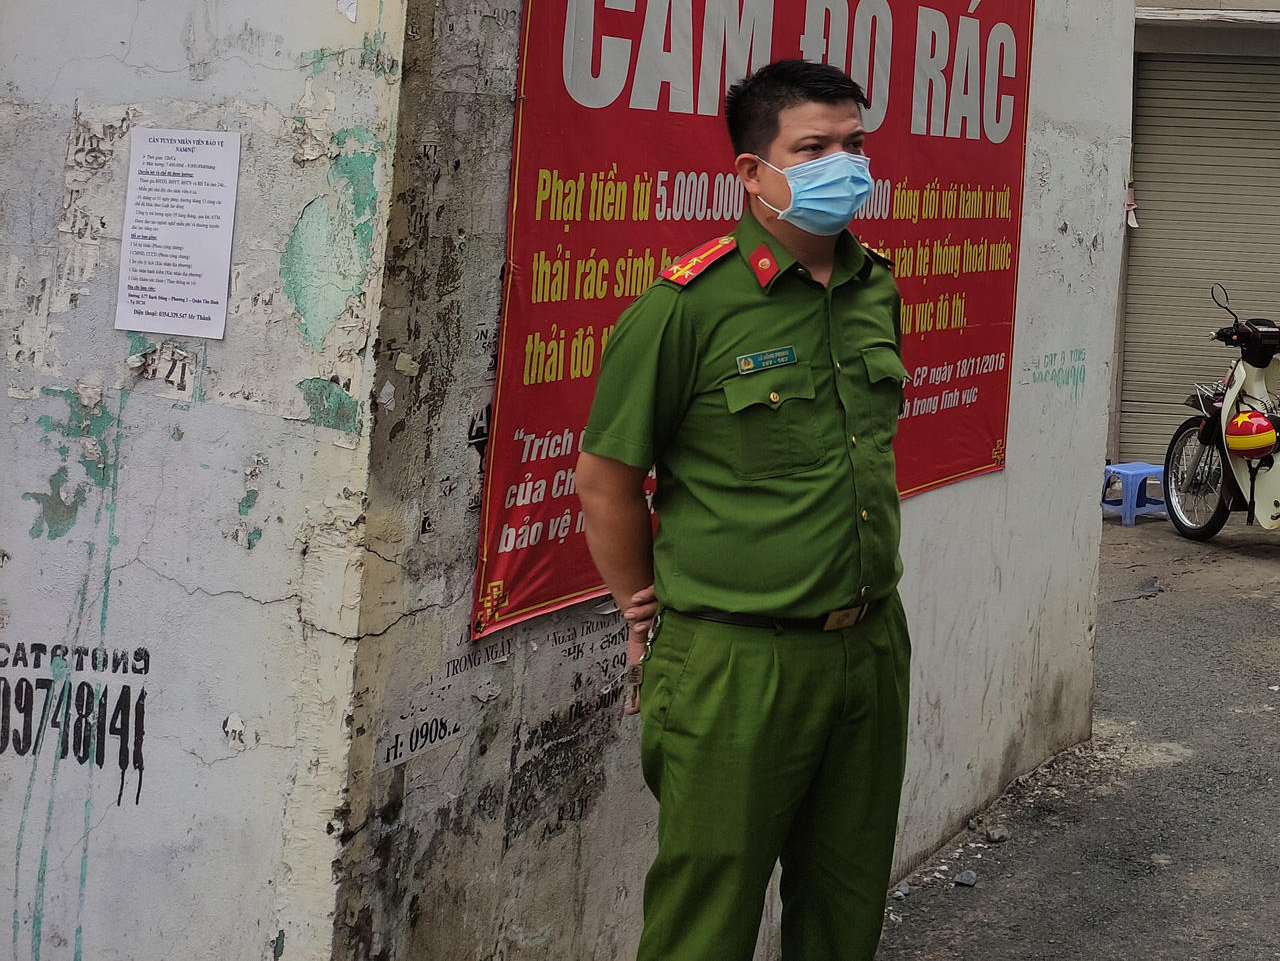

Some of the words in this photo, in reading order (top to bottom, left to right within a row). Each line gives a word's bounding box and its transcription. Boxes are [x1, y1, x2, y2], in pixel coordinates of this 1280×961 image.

[535, 168, 585, 232] Phạt
[589, 162, 628, 221] tiền
[632, 172, 653, 221] từ
[893, 177, 920, 224] đồng
[942, 183, 958, 219] với
[959, 183, 983, 219] hành
[986, 184, 994, 219] vi
[531, 244, 570, 304] thải
[574, 244, 609, 300] rác
[894, 240, 914, 278] vào
[916, 240, 929, 284] hệ
[932, 233, 961, 278] thống
[963, 237, 988, 274] thoát
[989, 236, 1012, 271] nước
[915, 299, 934, 340] vực
[936, 293, 949, 330] đô
[523, 324, 565, 385] thải
[570, 325, 594, 379] đô
[929, 362, 953, 387] ngày
[956, 352, 1005, 379] 18/11/2016
[912, 394, 939, 417] trong
[961, 386, 979, 408] vực
[504, 473, 546, 509] của
[498, 516, 543, 553] bảo
[548, 509, 571, 544] vệ
